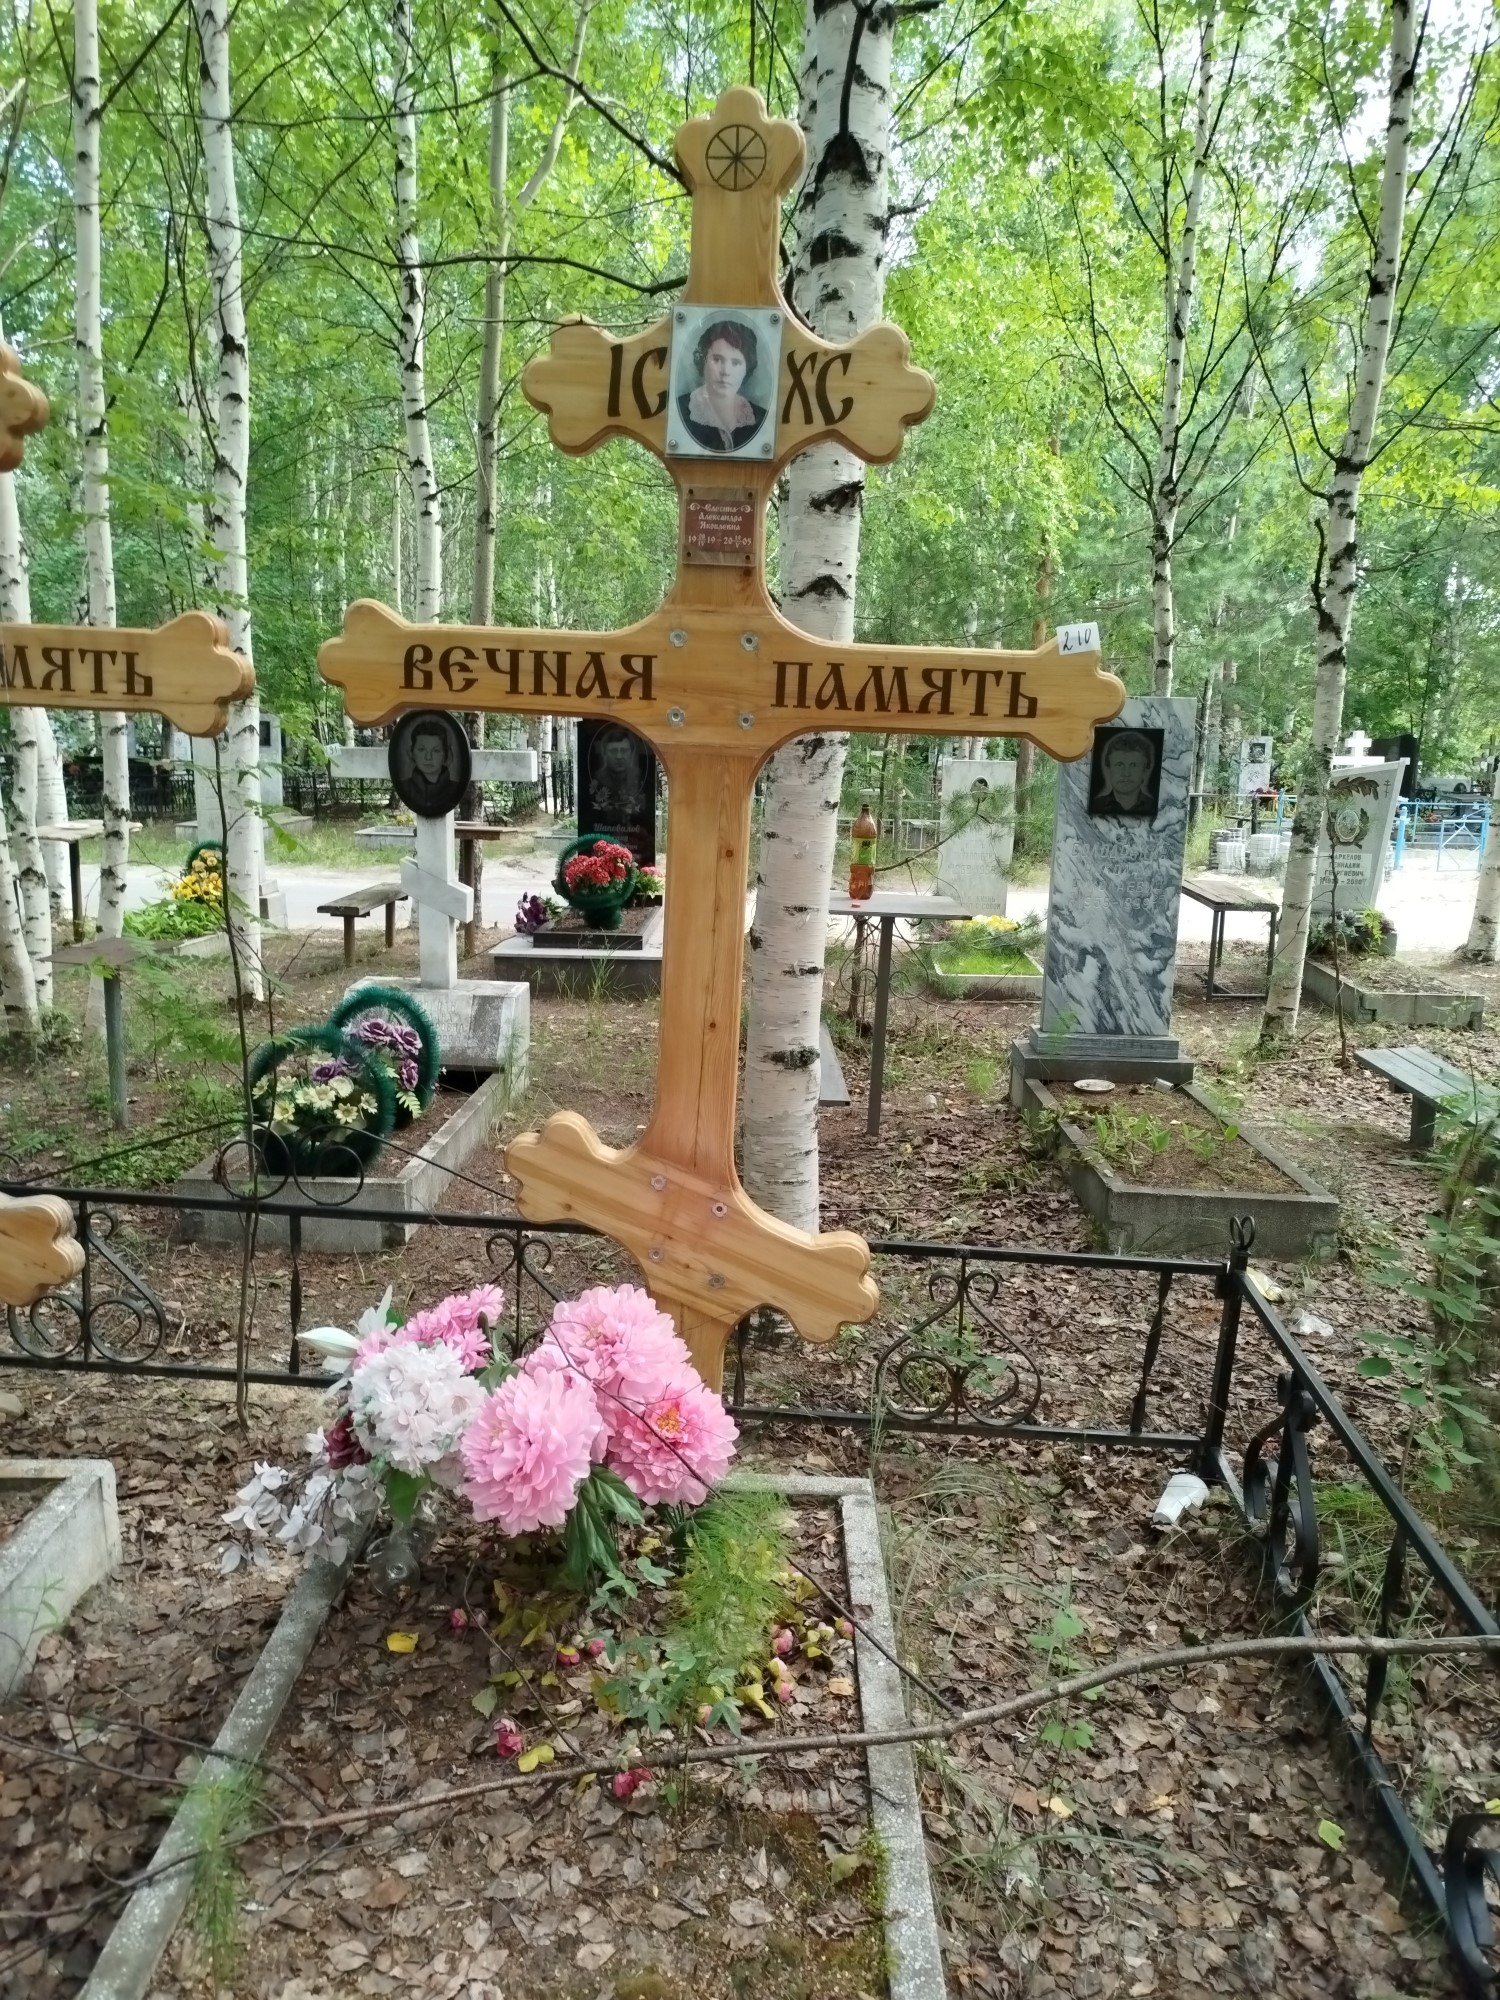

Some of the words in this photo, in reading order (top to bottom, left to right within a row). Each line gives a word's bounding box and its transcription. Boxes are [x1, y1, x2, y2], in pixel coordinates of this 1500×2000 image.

[1062, 627, 1093, 651] 210
[399, 643, 658, 701] ВЕЧНАЯ
[770, 660, 1039, 719] ПАМЯТЬ
